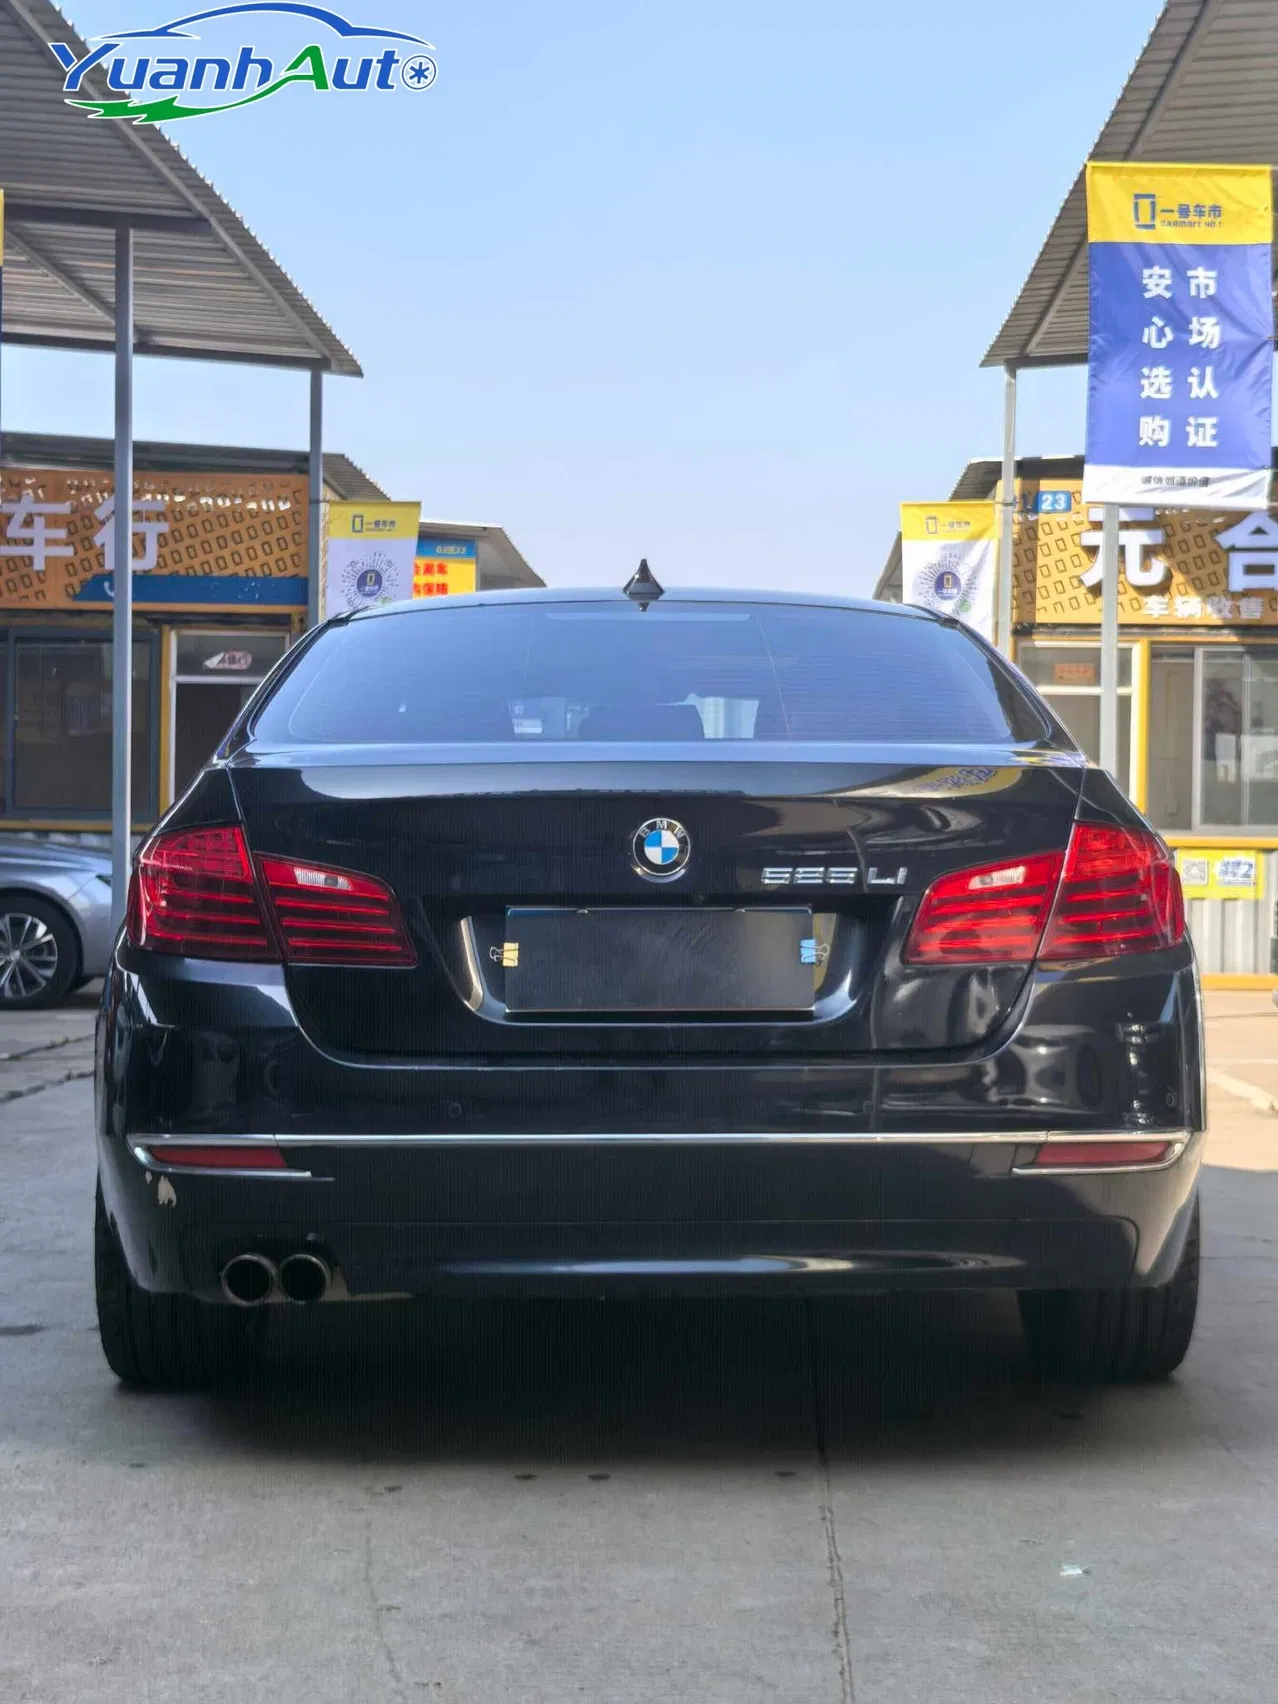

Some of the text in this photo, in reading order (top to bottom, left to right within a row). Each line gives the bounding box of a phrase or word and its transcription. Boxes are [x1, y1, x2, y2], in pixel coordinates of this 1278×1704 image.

[1160, 204, 1222, 219] 一号车市
[1138, 265, 1175, 448] 安心选购
[1186, 266, 1220, 448] 市场认证
[0, 494, 169, 571] 车行
[1041, 493, 1067, 511] 23
